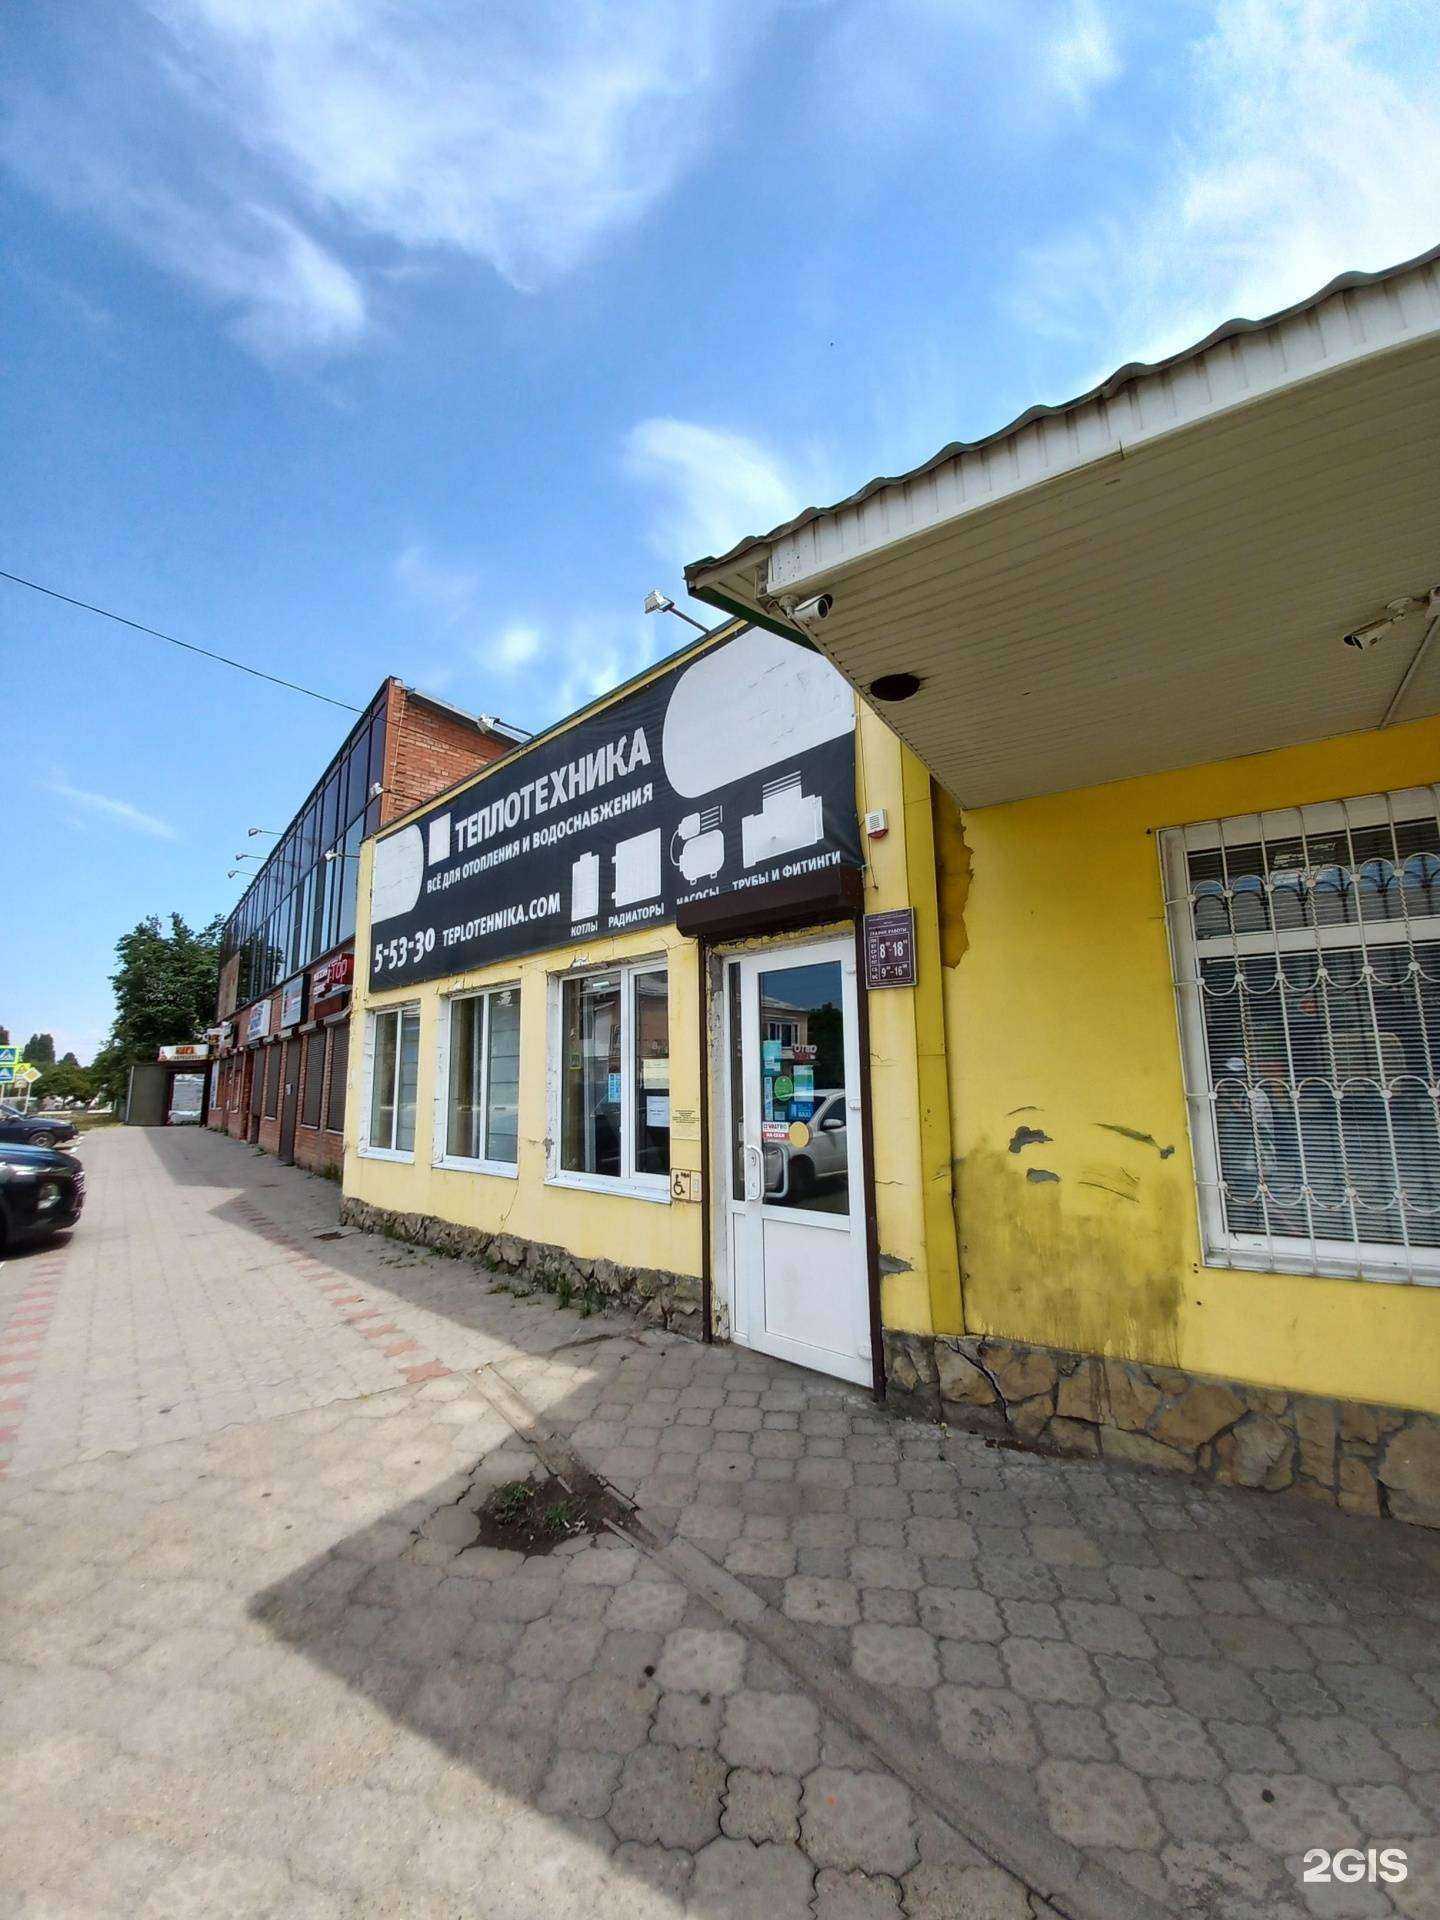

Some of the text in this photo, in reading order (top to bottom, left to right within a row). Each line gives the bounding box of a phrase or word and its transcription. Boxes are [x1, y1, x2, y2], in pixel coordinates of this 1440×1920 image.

[455, 726, 652, 853] ТЕПЛОТЕХНИКА
[427, 783, 654, 894] ВСЁ ДЛЯ ОТОПЛЕНИЯ И ВОДОСНАБЖЕНИЯ
[732, 850, 842, 891] ТРУБЫ И ФИТИНГИ
[374, 891, 561, 974] 5-53-30 TEPLOTEHNIKA.COM
[570, 920, 598, 937] КОТЛЫ
[607, 902, 665, 928] РАДИАТОРЫ
